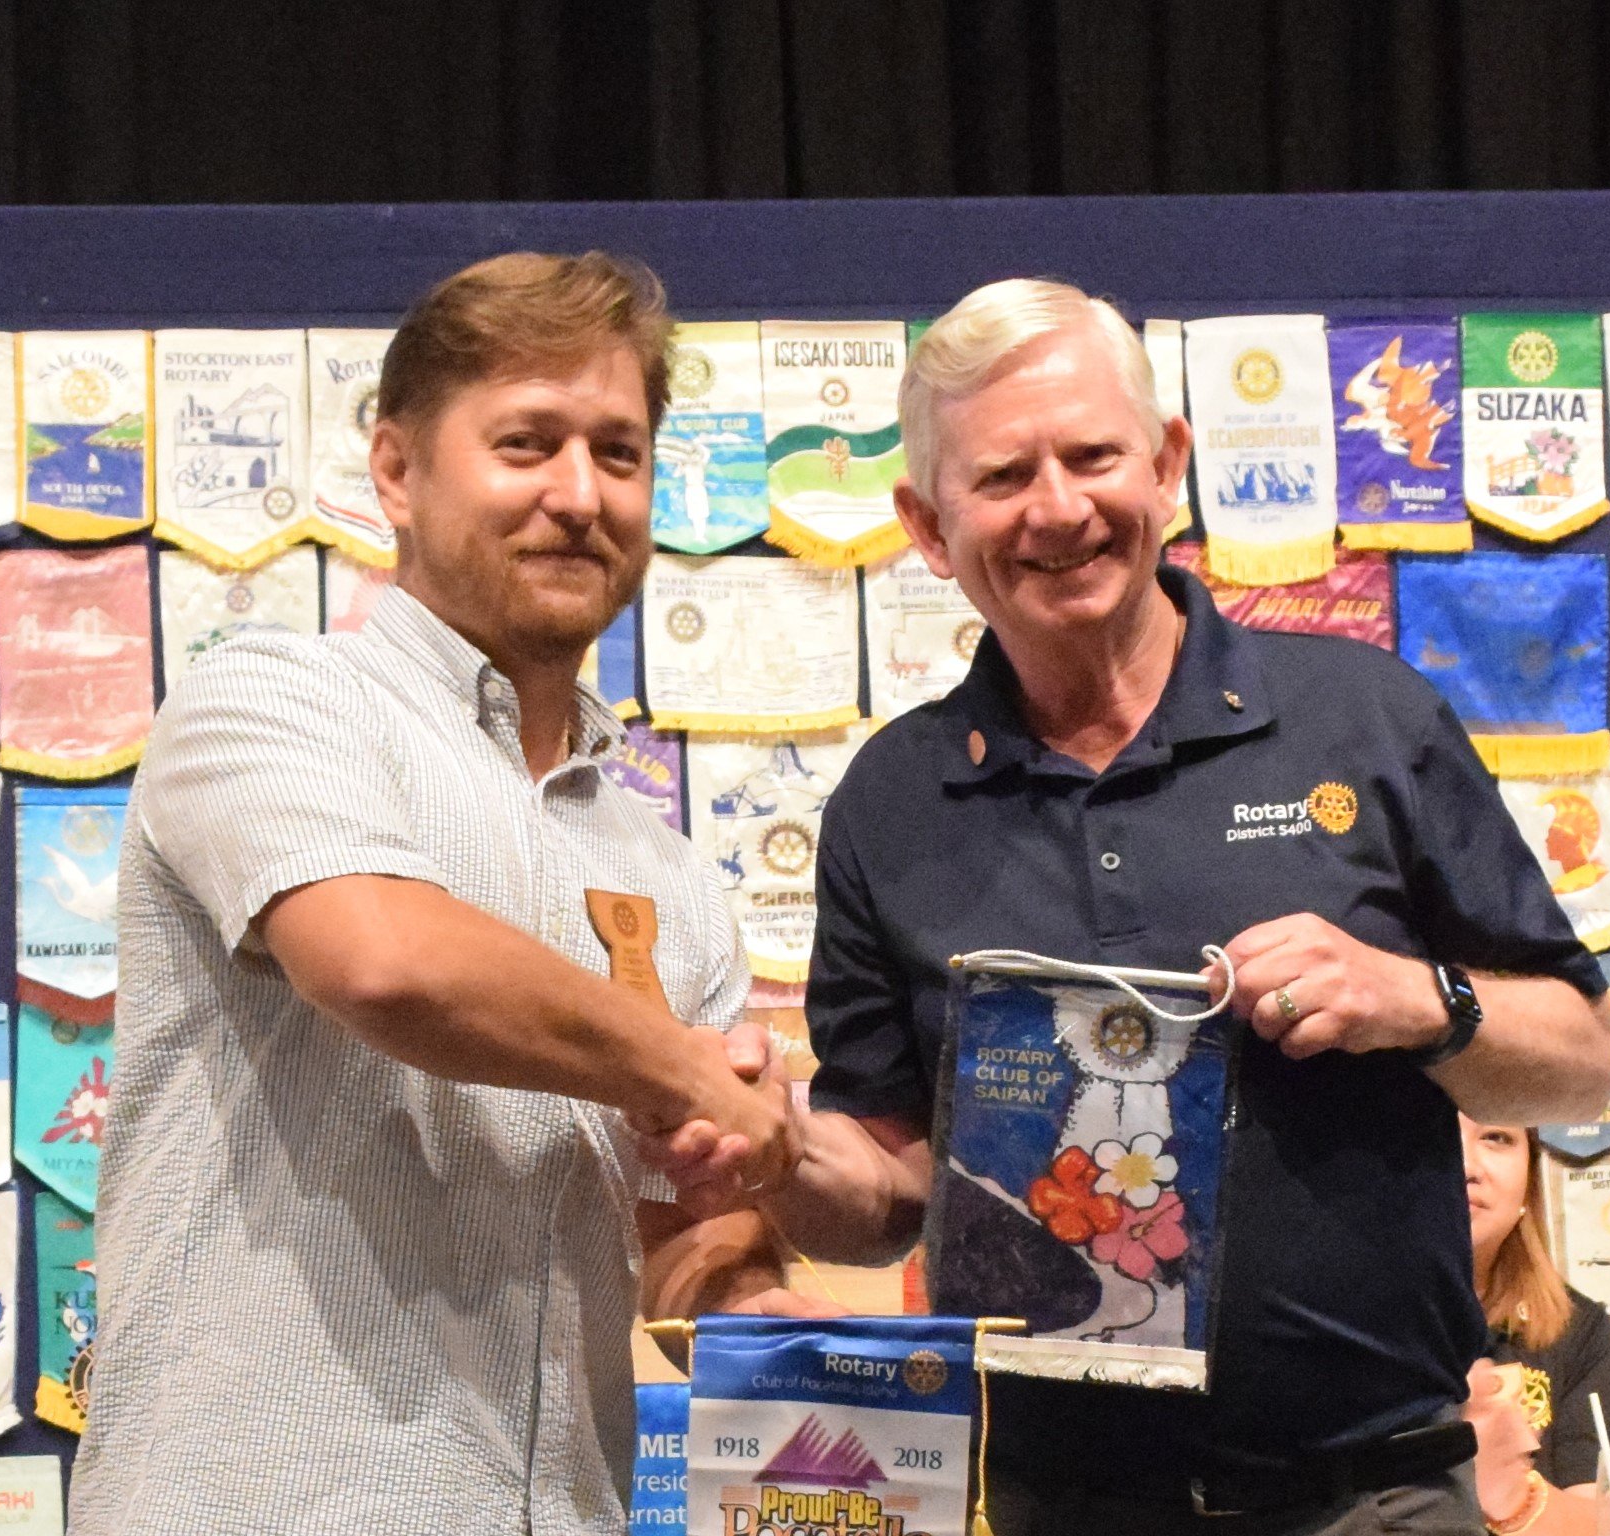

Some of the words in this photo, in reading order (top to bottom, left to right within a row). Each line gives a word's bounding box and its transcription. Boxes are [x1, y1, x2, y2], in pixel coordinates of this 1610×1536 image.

[164, 352, 251, 366] STOCKTON
[256, 353, 294, 366] EAST
[774, 341, 841, 369] ISESAKI
[843, 340, 896, 368] SOUTH
[164, 369, 232, 382] ROTARY
[819, 412, 856, 424] JAPAN
[1476, 392, 1588, 423] SUZAKA
[721, 417, 750, 431] CLUB
[1207, 426, 1321, 448] SCARBOROUGH
[700, 589, 732, 598] CLUB
[1254, 597, 1324, 617] ROTARY
[1333, 600, 1382, 618] CLUB
[1233, 797, 1310, 823] Rotary
[1226, 824, 1276, 842] District
[1278, 818, 1312, 836] 5400
[976, 1047, 1056, 1066] ROTARY
[975, 1065, 1033, 1085] CLUB
[1036, 1070, 1064, 1087] OF
[974, 1084, 1048, 1104] SAIPAN
[1567, 1125, 1601, 1137] JAPAN
[1568, 1168, 1604, 1181] ROTARY
[825, 1353, 898, 1381] Rotary
[751, 1374, 787, 1389] Club
[789, 1376, 799, 1388] of
[864, 1383, 899, 1399] Idaho
[713, 1436, 760, 1458] 1918
[893, 1447, 943, 1471] 2018
[761, 1486, 836, 1524] Proud
[835, 1491, 849, 1511] to
[849, 1491, 883, 1526] Be
